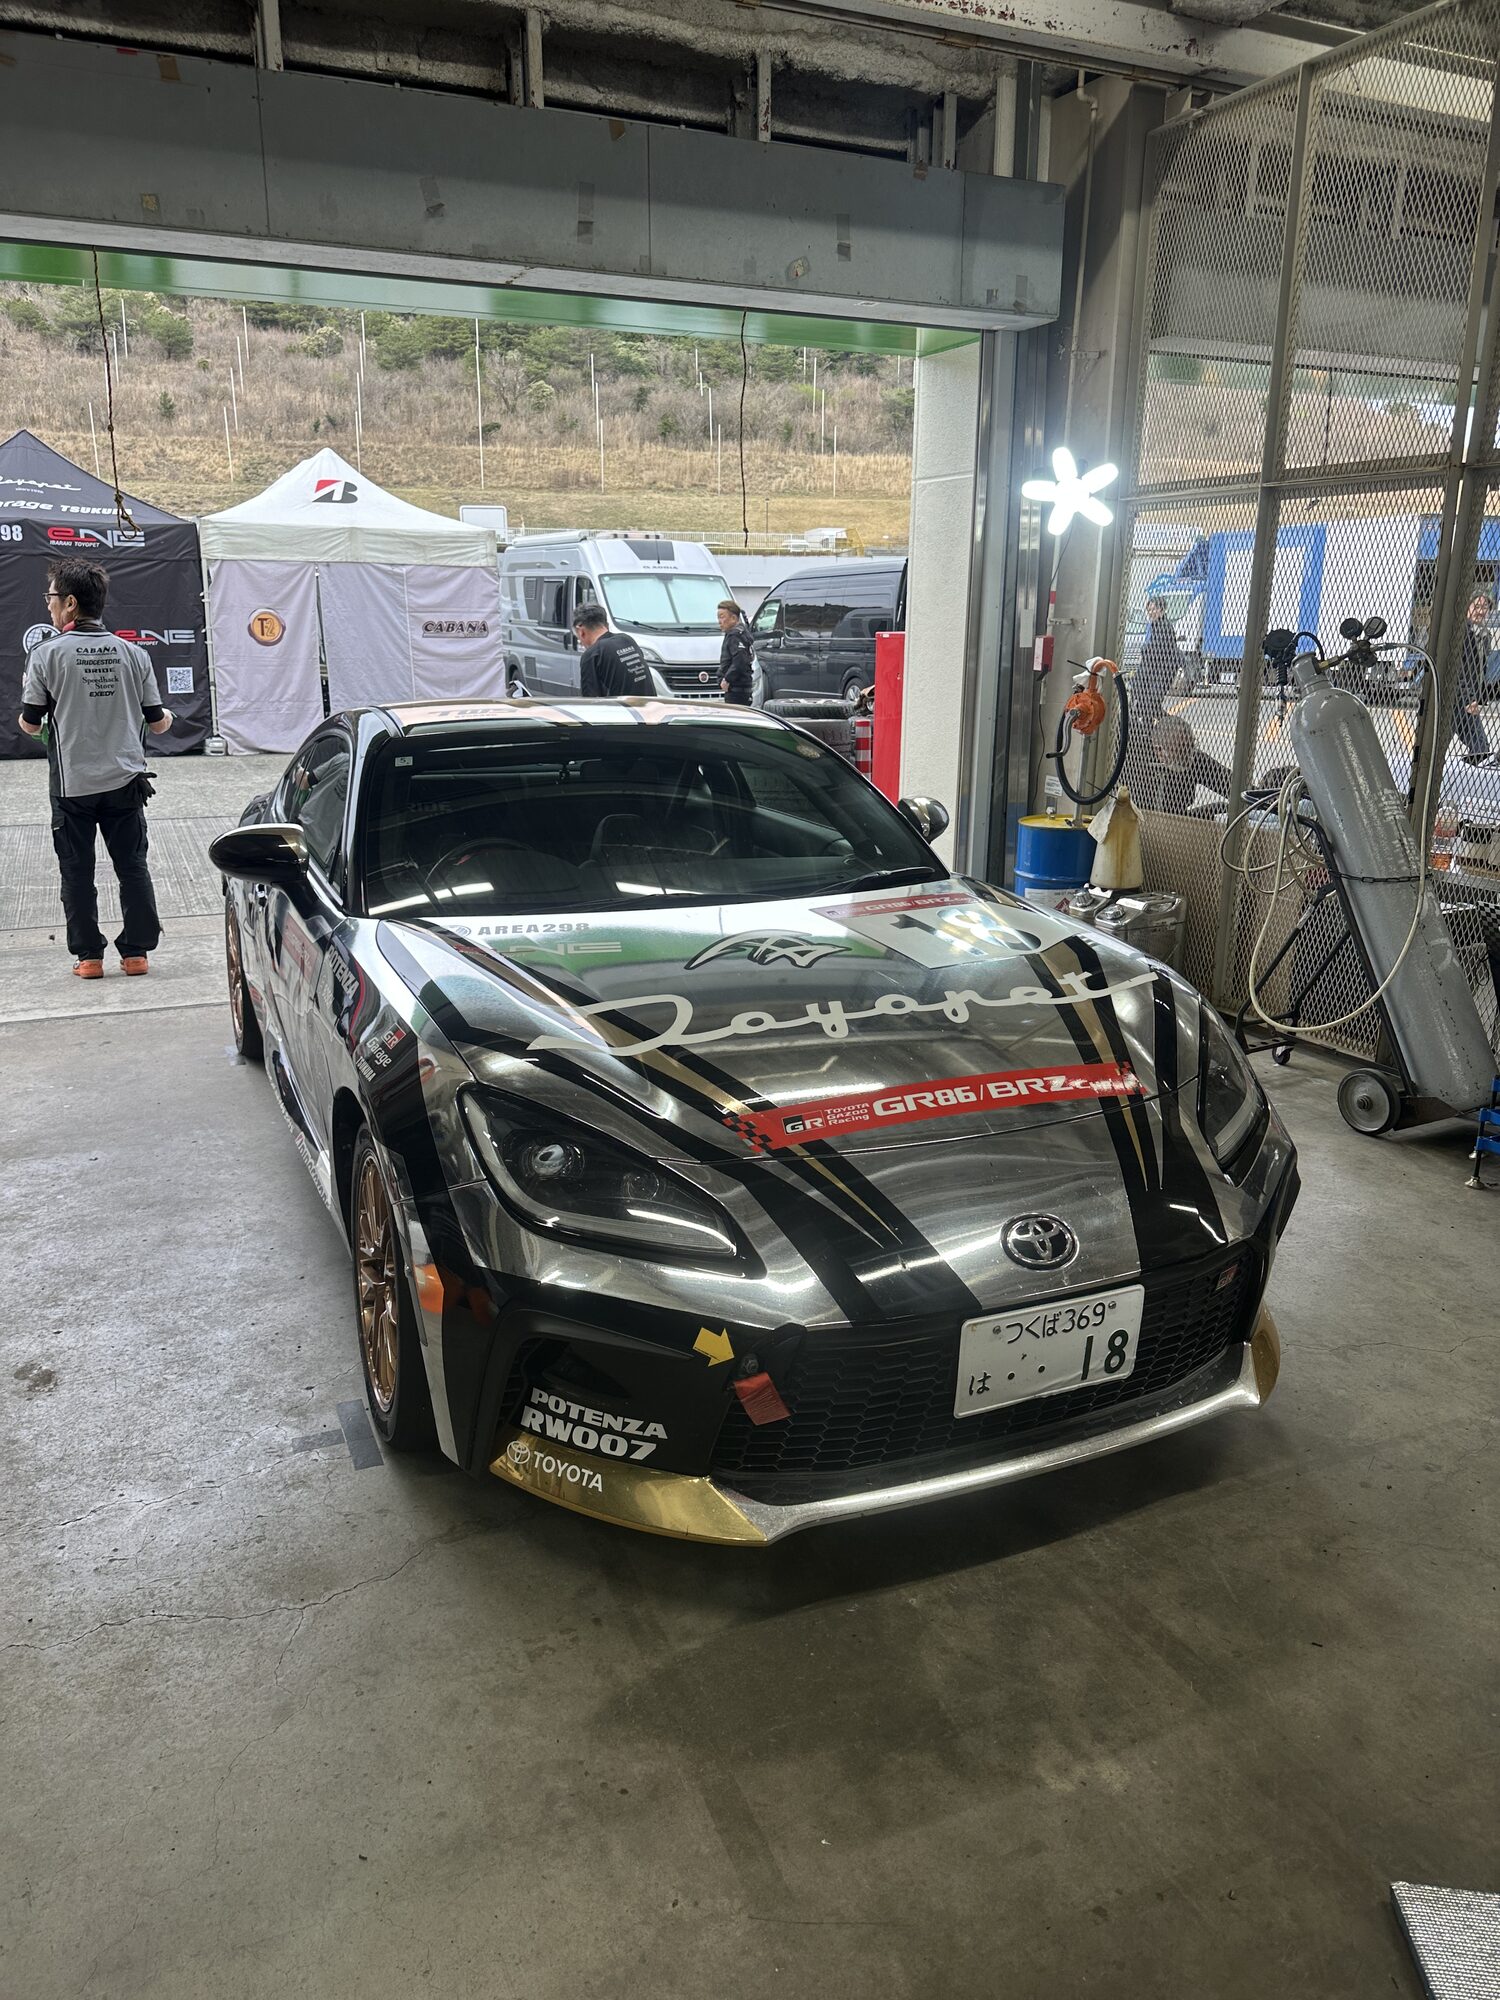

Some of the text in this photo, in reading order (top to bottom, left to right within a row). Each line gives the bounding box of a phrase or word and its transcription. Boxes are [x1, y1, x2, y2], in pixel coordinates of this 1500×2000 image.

[76, 658, 122, 666] BRIDGESTONE
[89, 690, 116, 698] EXEDY
[477, 922, 591, 937] AREA298
[365, 1036, 393, 1068] Garage
[355, 1055, 377, 1083] TSUKUBA
[824, 1102, 870, 1115] TOYOTA
[826, 1108, 869, 1121] GAZOO
[785, 1117, 824, 1134] GR
[828, 1114, 870, 1126] Racing
[1080, 1329, 1129, 1381] 18
[968, 1371, 992, 1396] は
[530, 1387, 668, 1439] POTENZA
[520, 1405, 657, 1461] RW007
[533, 1450, 603, 1492] TOYOTA
